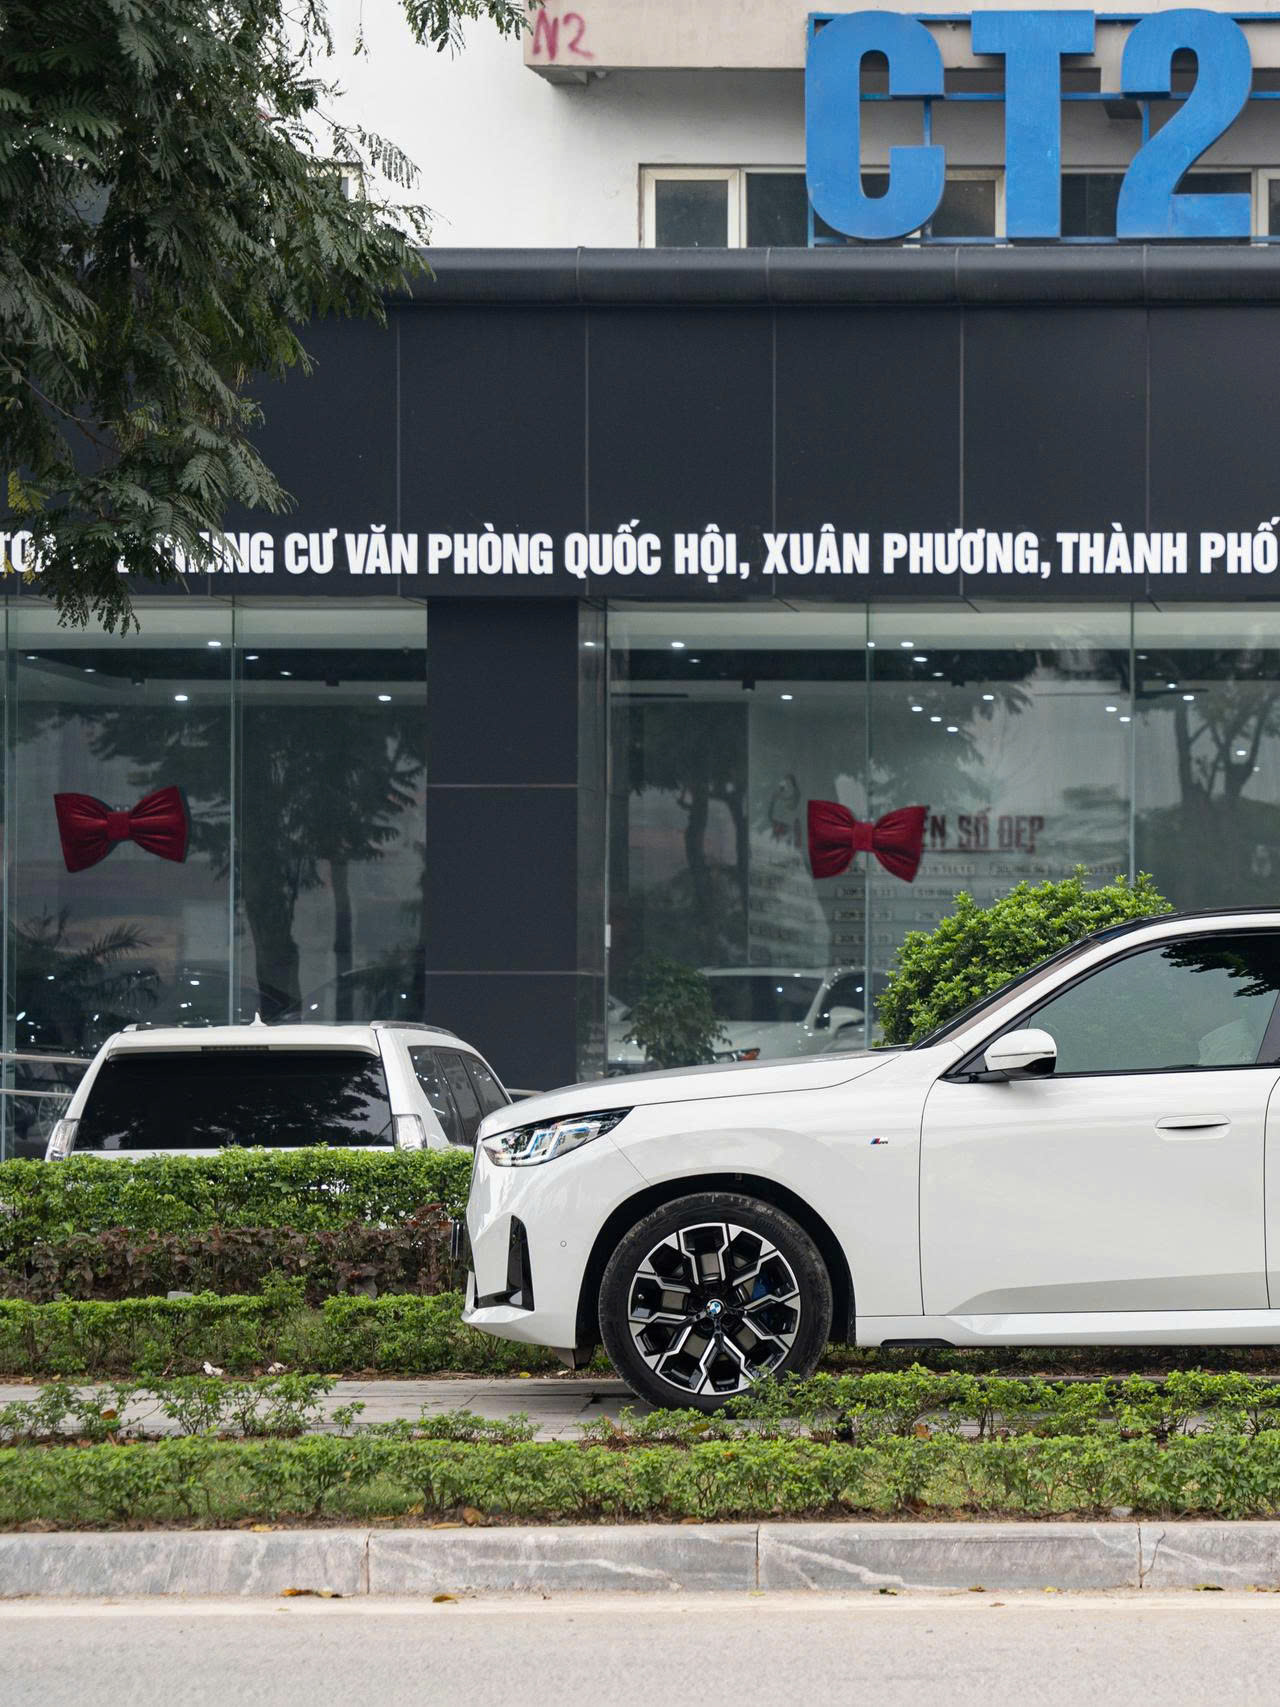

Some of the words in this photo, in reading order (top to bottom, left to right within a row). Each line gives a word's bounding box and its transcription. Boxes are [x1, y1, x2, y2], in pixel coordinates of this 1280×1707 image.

[533, 7, 595, 61] N2
[284, 528, 338, 575] CƯ
[345, 523, 418, 575] VĂN
[428, 522, 555, 575] PHÒNG
[564, 518, 662, 579] QUỐC
[674, 523, 750, 583] HỘI,
[762, 523, 870, 575] XUÂN
[883, 527, 1051, 579] PHƯƠNG,
[1056, 522, 1188, 574] THÀNH
[1200, 516, 1280, 574] PHỐ
